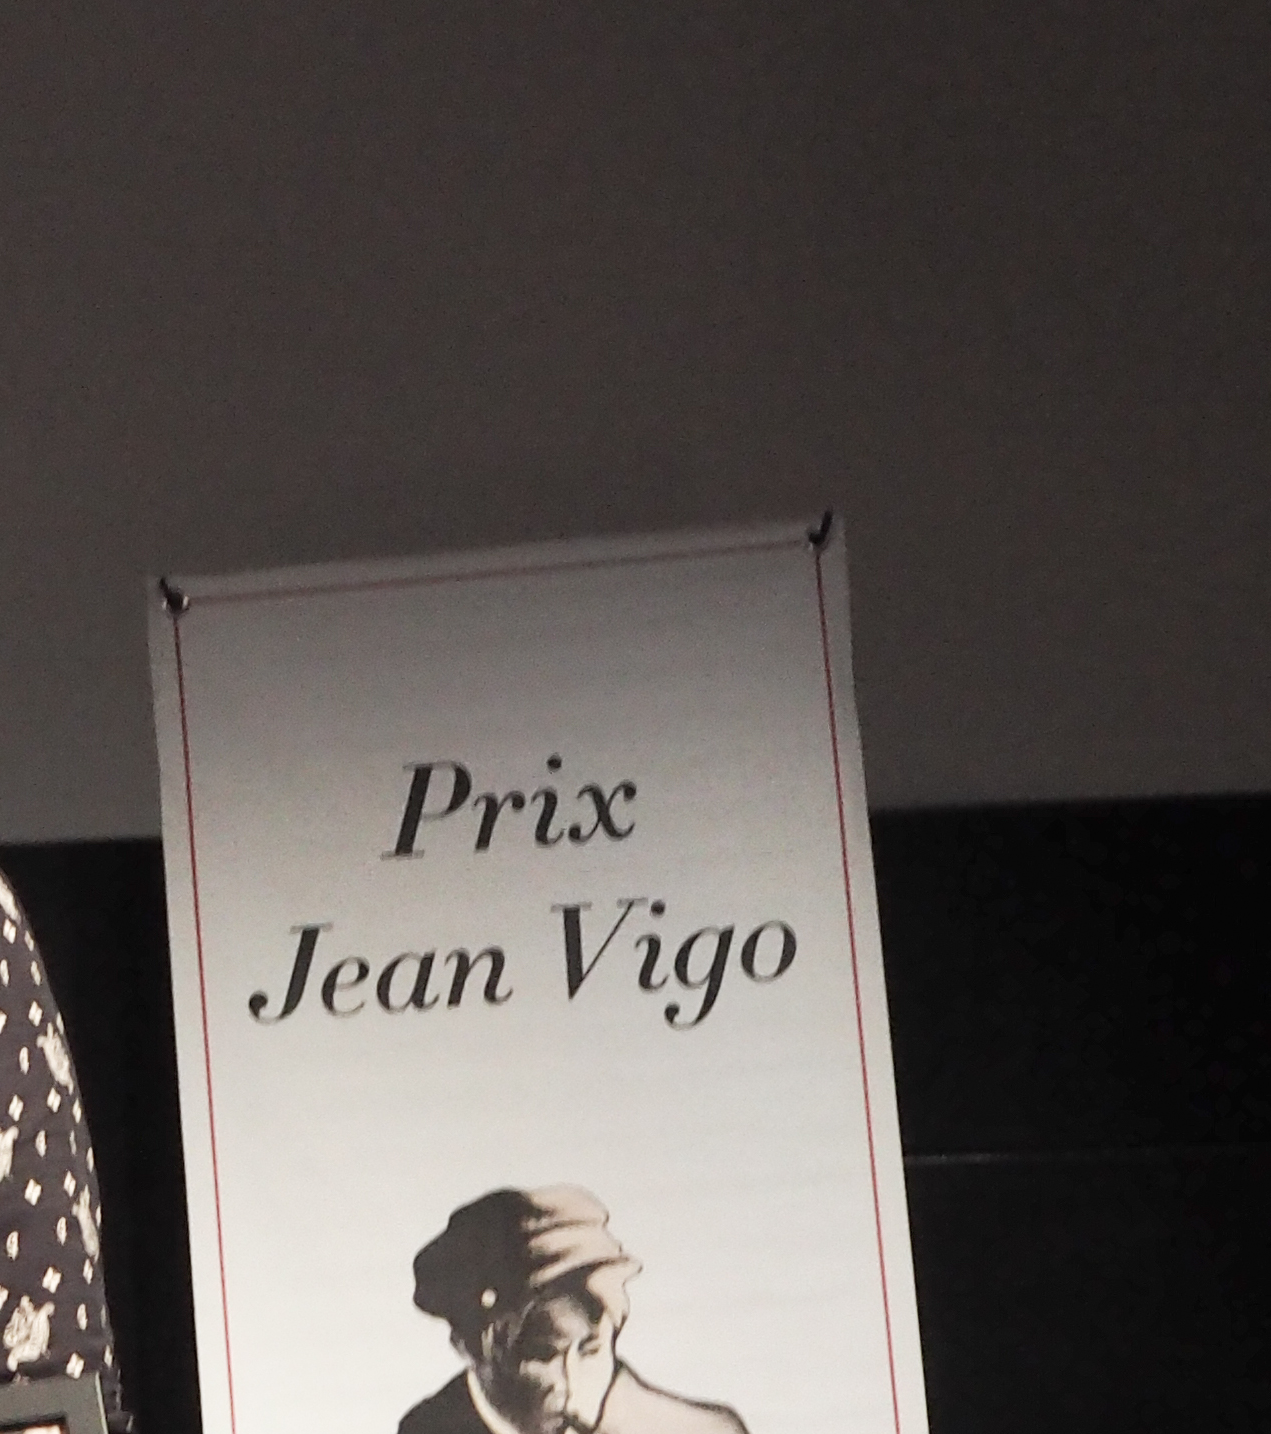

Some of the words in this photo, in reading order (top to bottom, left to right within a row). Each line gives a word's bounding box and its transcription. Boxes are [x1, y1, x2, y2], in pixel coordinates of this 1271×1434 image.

[379, 752, 638, 861] Prix
[248, 921, 513, 1025] Jean
[550, 896, 797, 1032] Vigo
